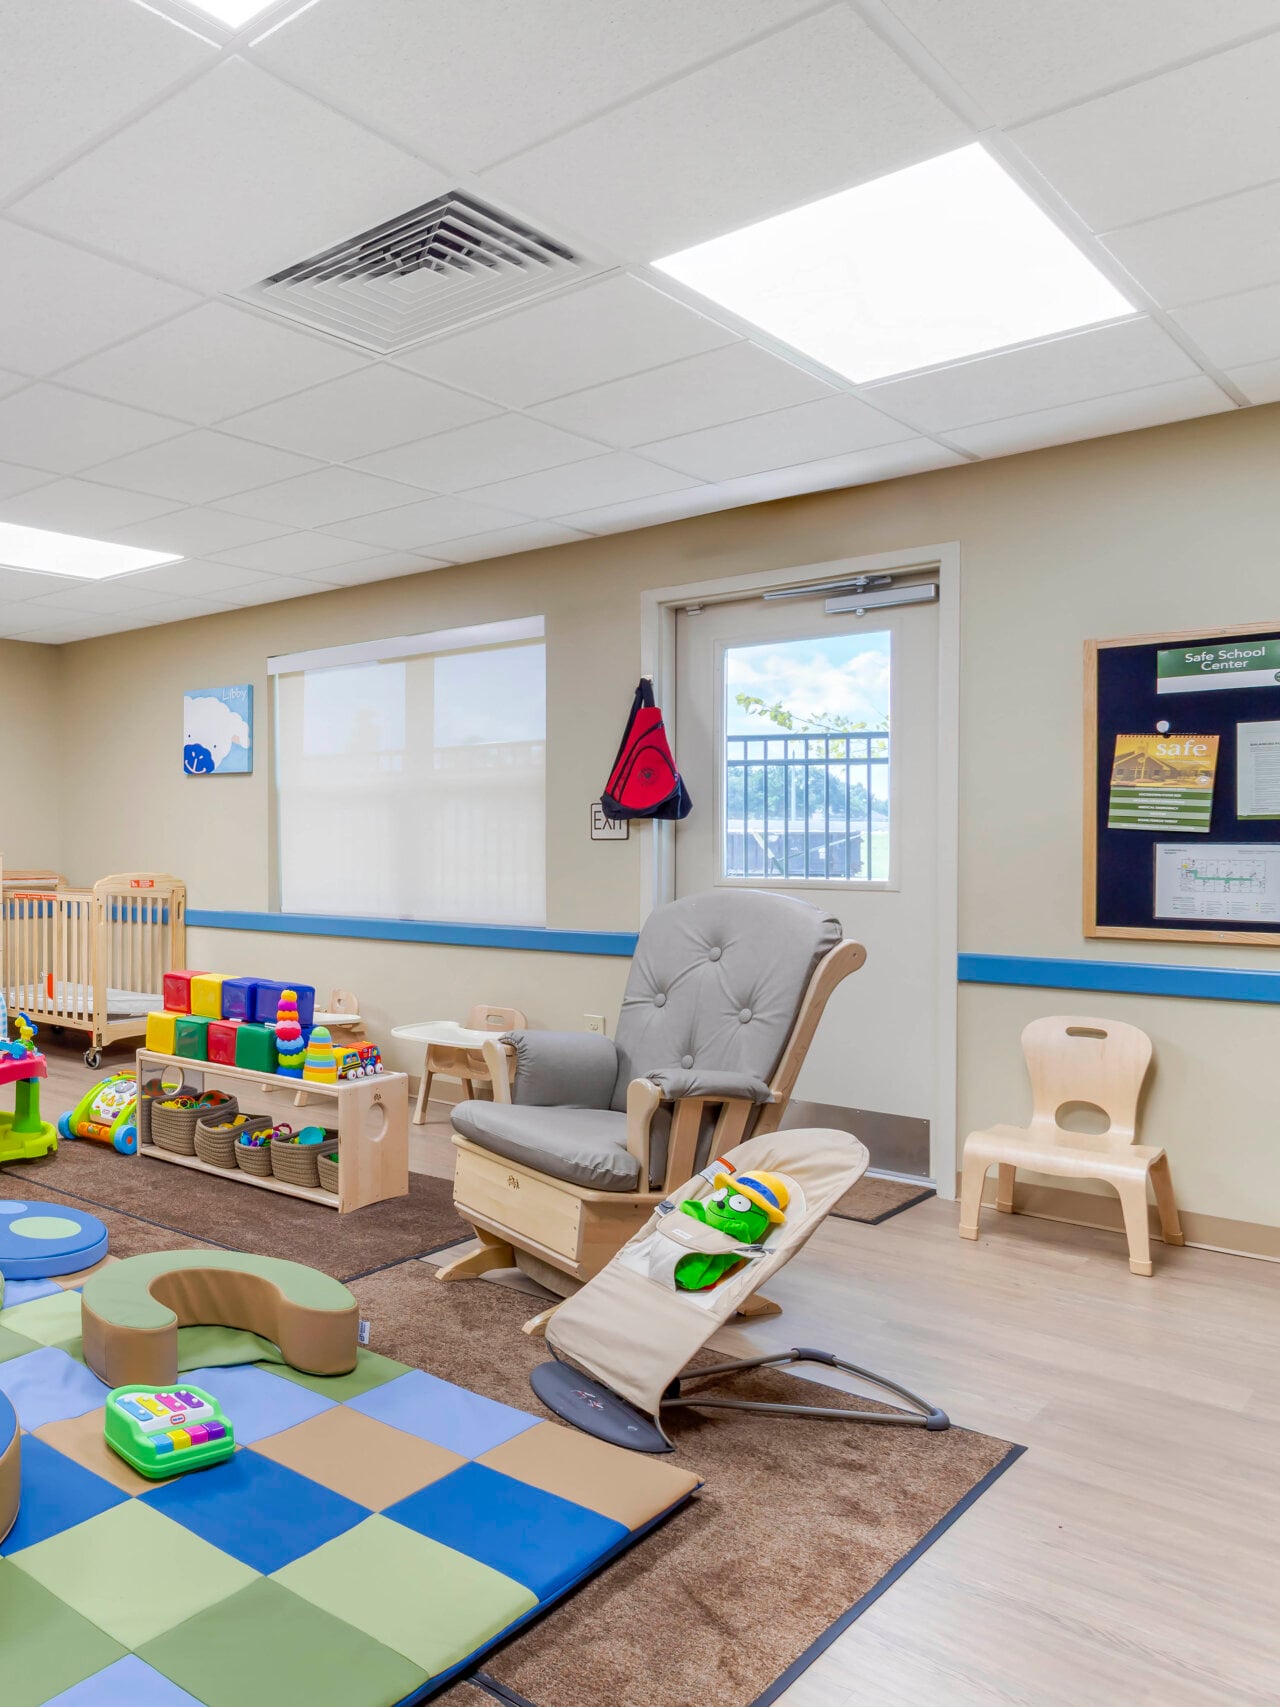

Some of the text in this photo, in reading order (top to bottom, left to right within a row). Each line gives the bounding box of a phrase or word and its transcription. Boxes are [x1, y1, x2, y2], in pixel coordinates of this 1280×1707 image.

[1184, 646, 1266, 663] Safe School
[1200, 660, 1249, 671] Center
[222, 687, 248, 701] Libby
[1155, 739, 1207, 757] safe
